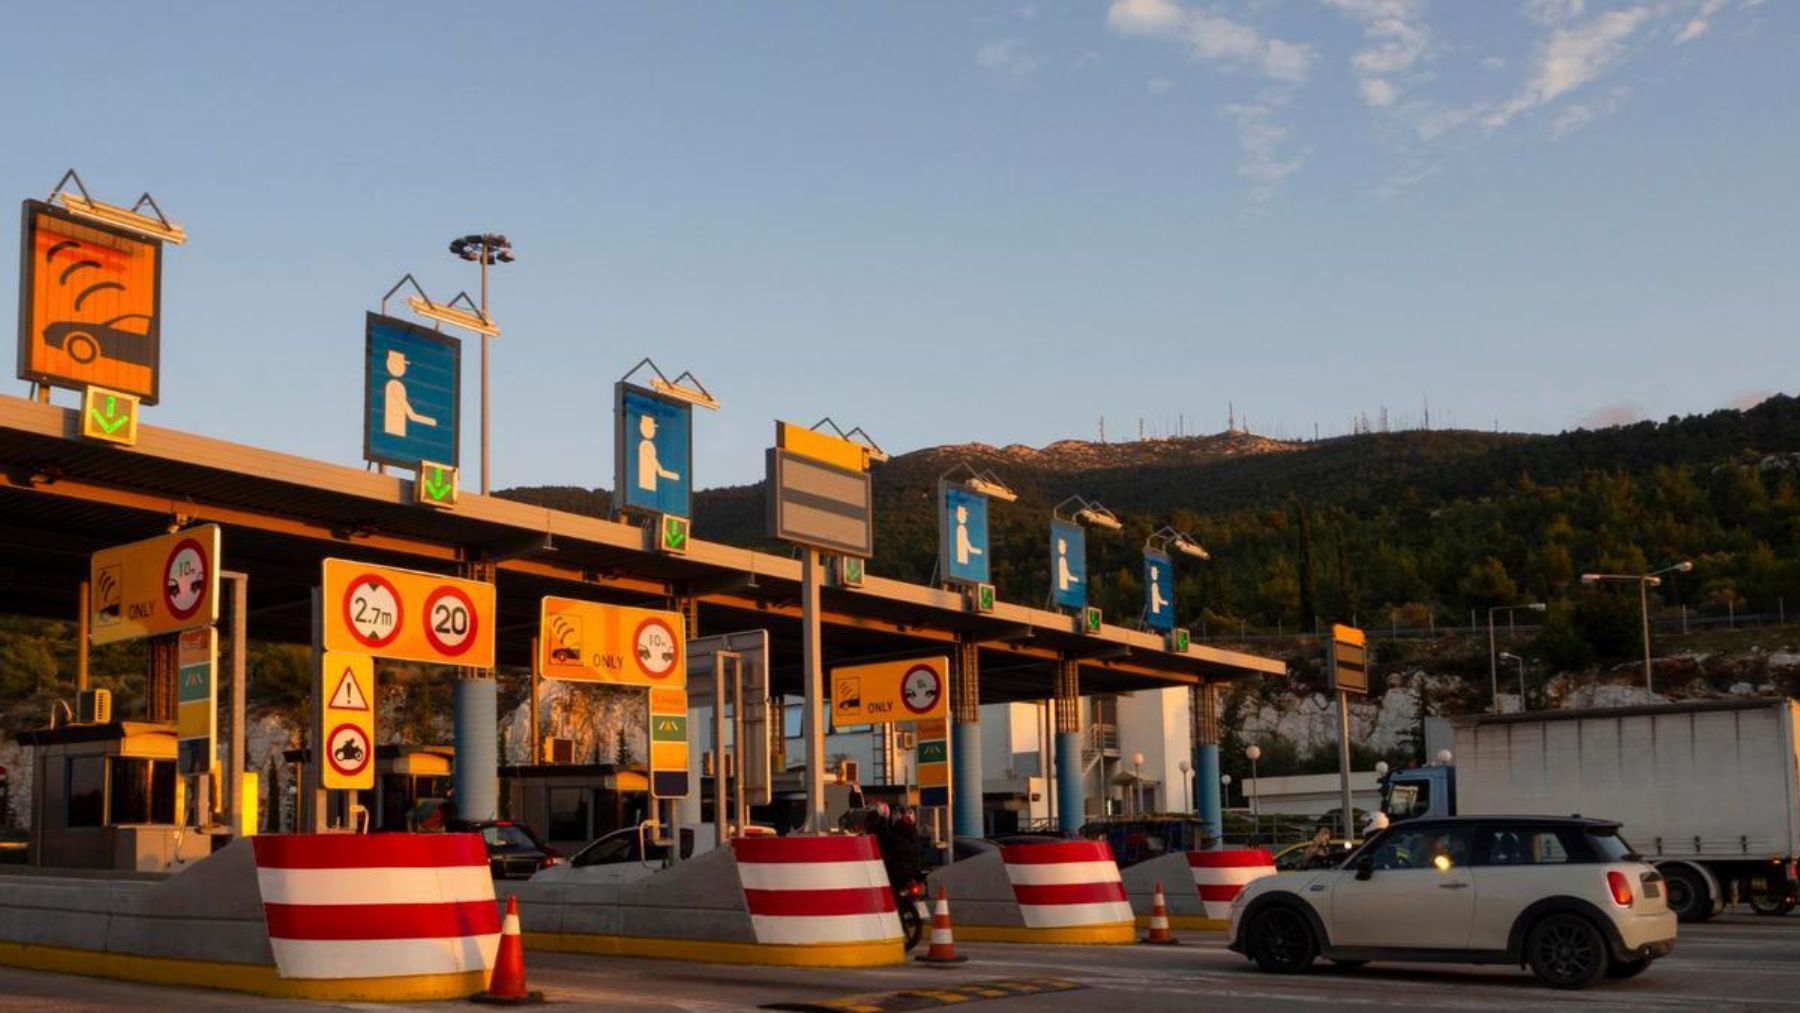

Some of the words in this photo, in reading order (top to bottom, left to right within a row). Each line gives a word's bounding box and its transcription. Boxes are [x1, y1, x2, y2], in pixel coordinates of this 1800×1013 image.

[128, 602, 155, 620] ONLY
[354, 597, 392, 626] 2.7m
[435, 604, 467, 635] 20
[593, 653, 624, 669] ONLY
[867, 701, 893, 713] ONLY
